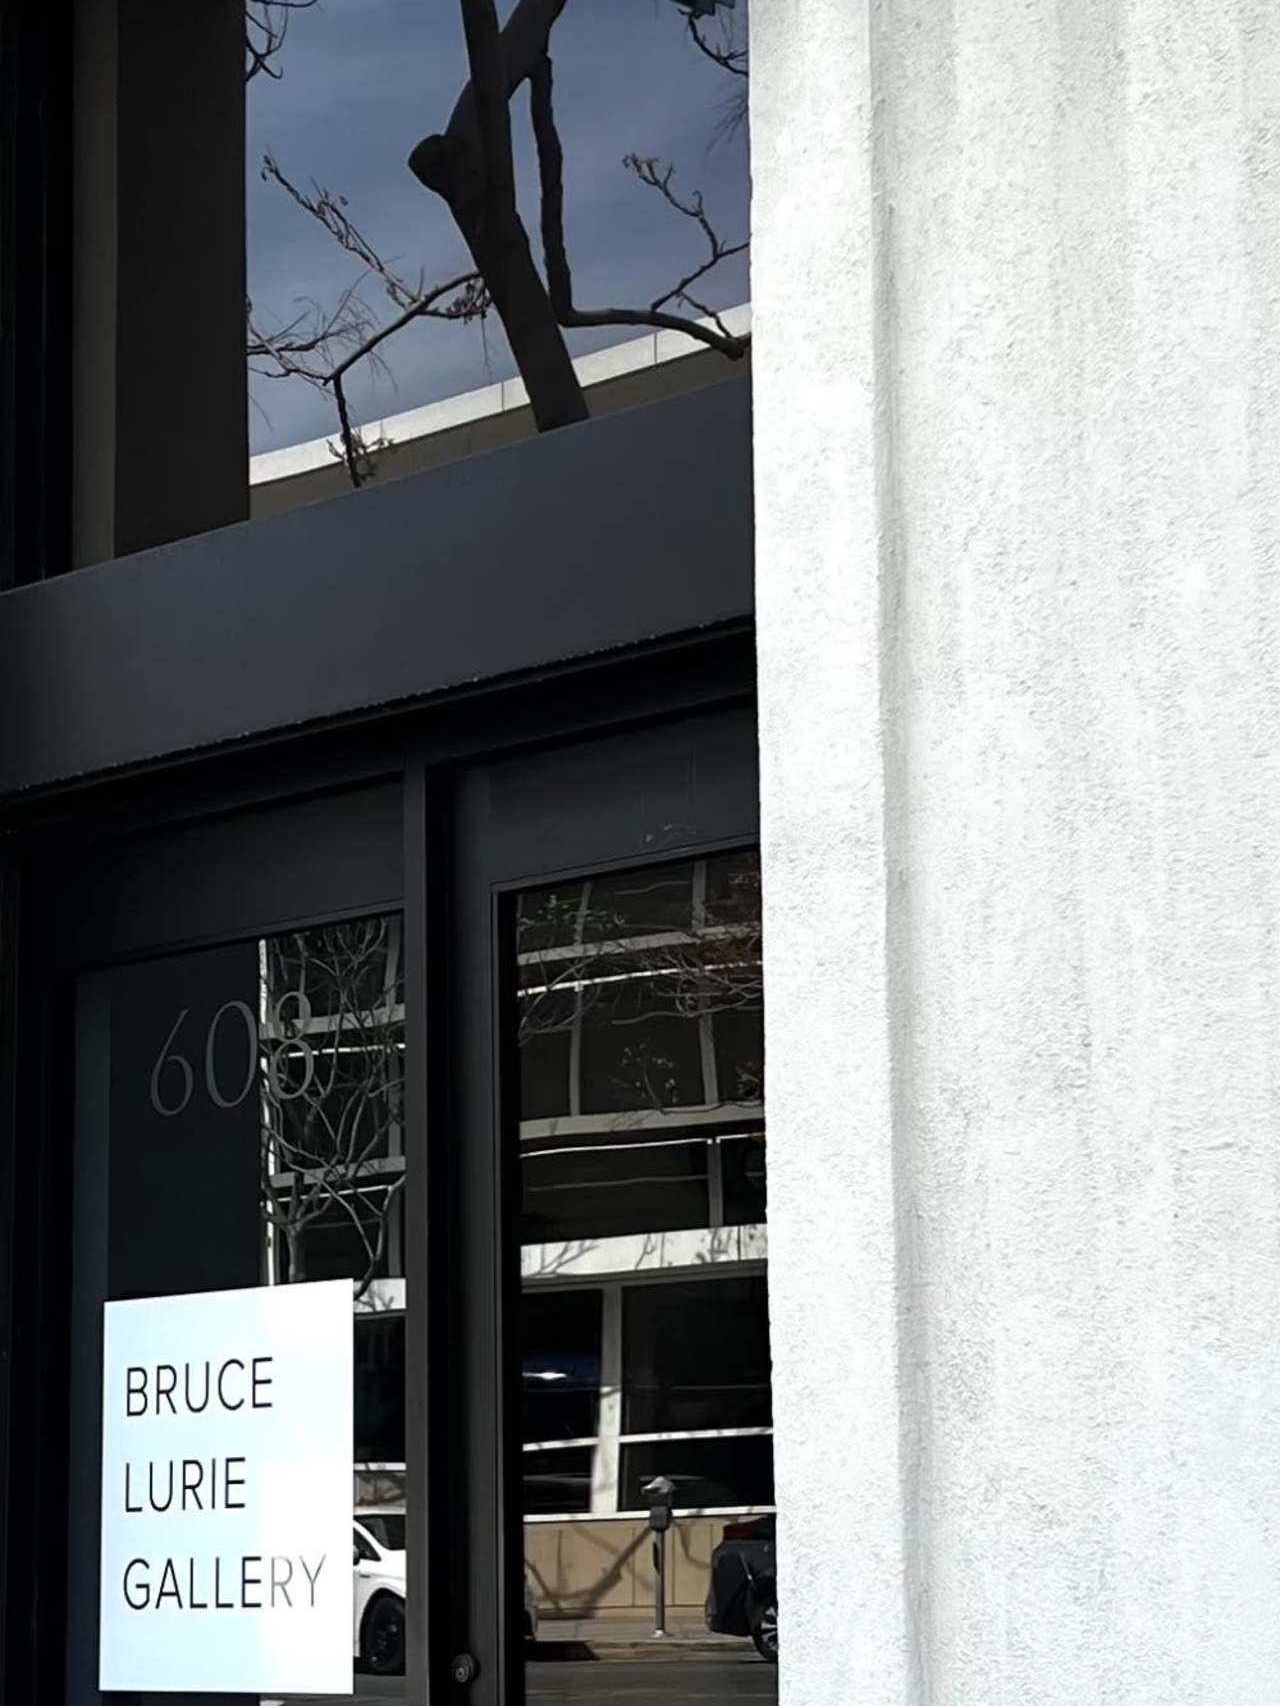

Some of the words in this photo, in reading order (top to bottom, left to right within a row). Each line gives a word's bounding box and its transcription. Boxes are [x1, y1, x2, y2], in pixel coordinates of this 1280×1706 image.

[149, 990, 315, 1117] 608
[125, 1355, 274, 1419] BRUCE
[123, 1455, 247, 1514] LURIE
[122, 1553, 328, 1612] GALLERY
